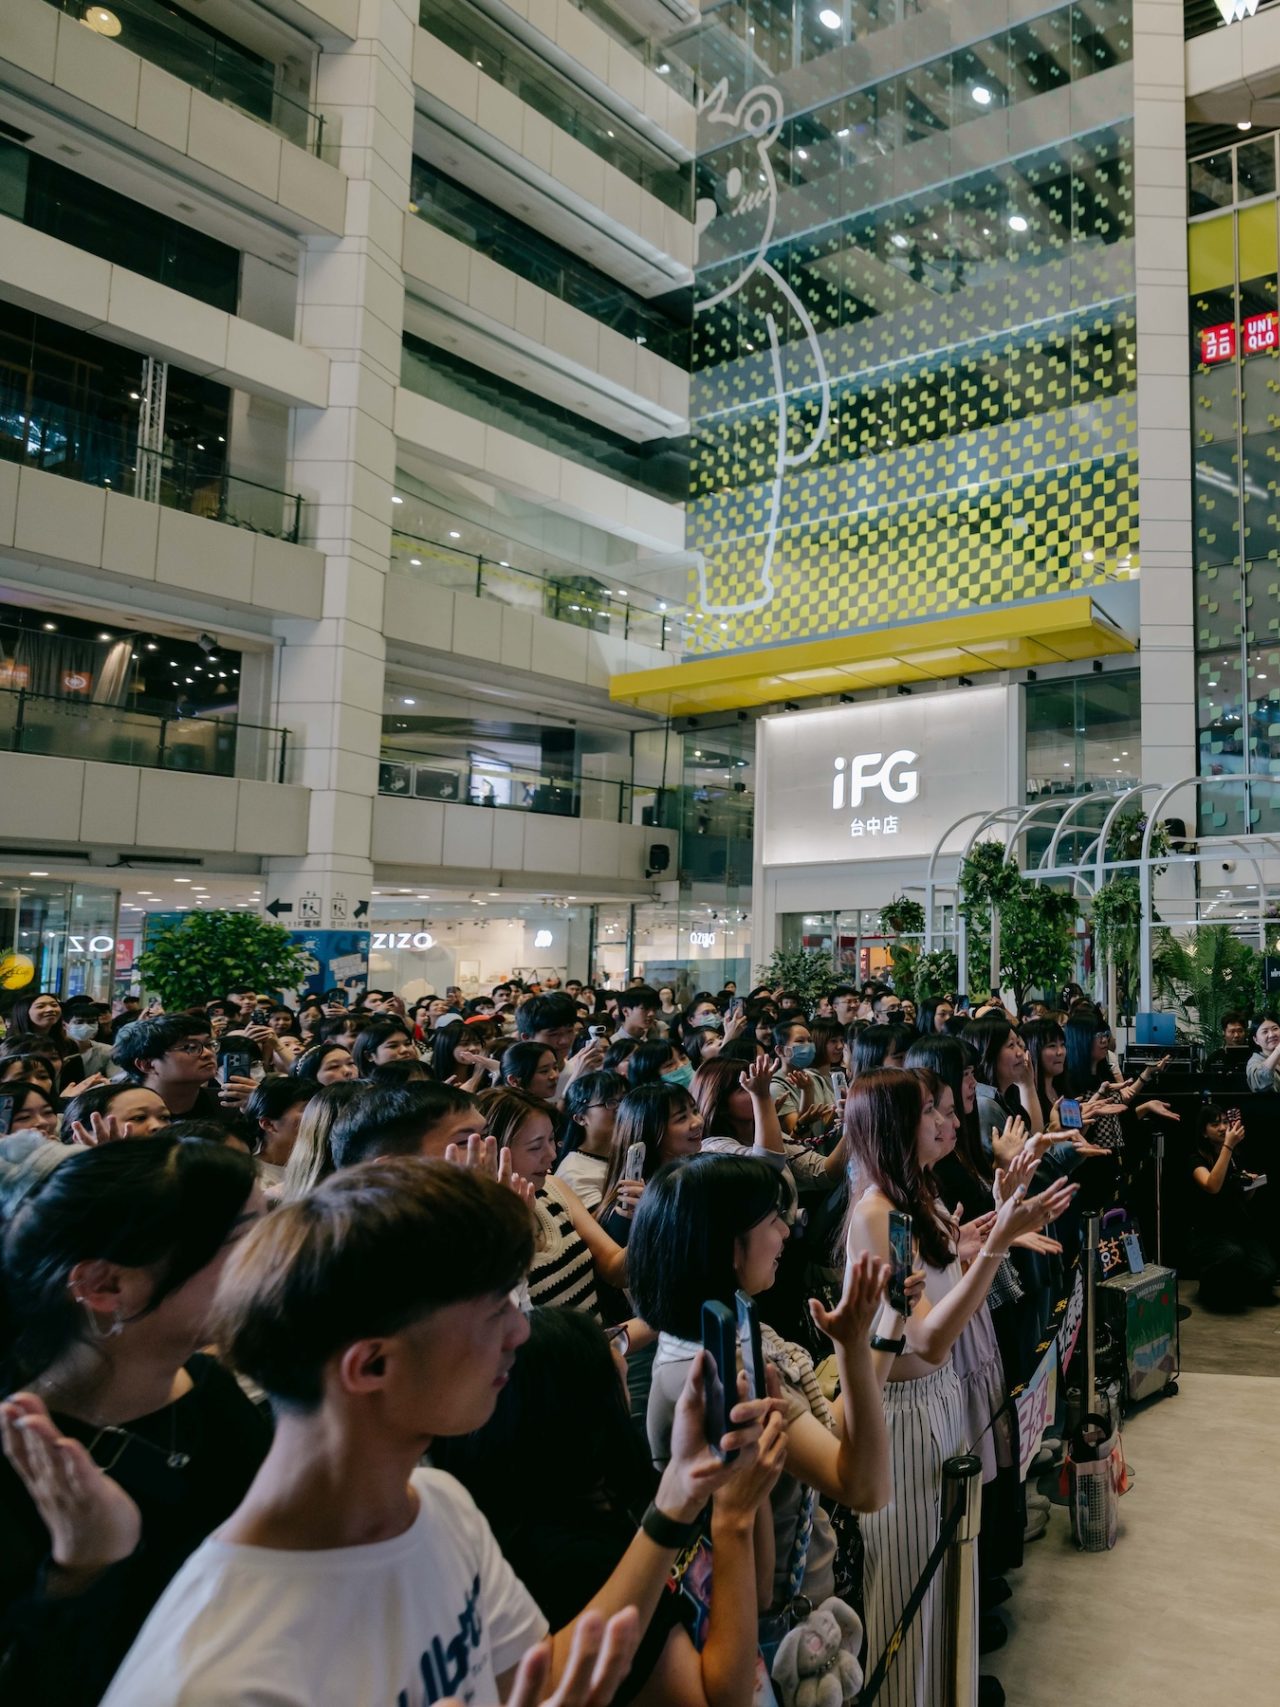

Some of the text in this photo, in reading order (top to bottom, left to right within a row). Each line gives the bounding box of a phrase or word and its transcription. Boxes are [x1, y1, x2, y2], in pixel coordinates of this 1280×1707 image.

[833, 750, 918, 809] iFG
[850, 815, 898, 837] 台中店
